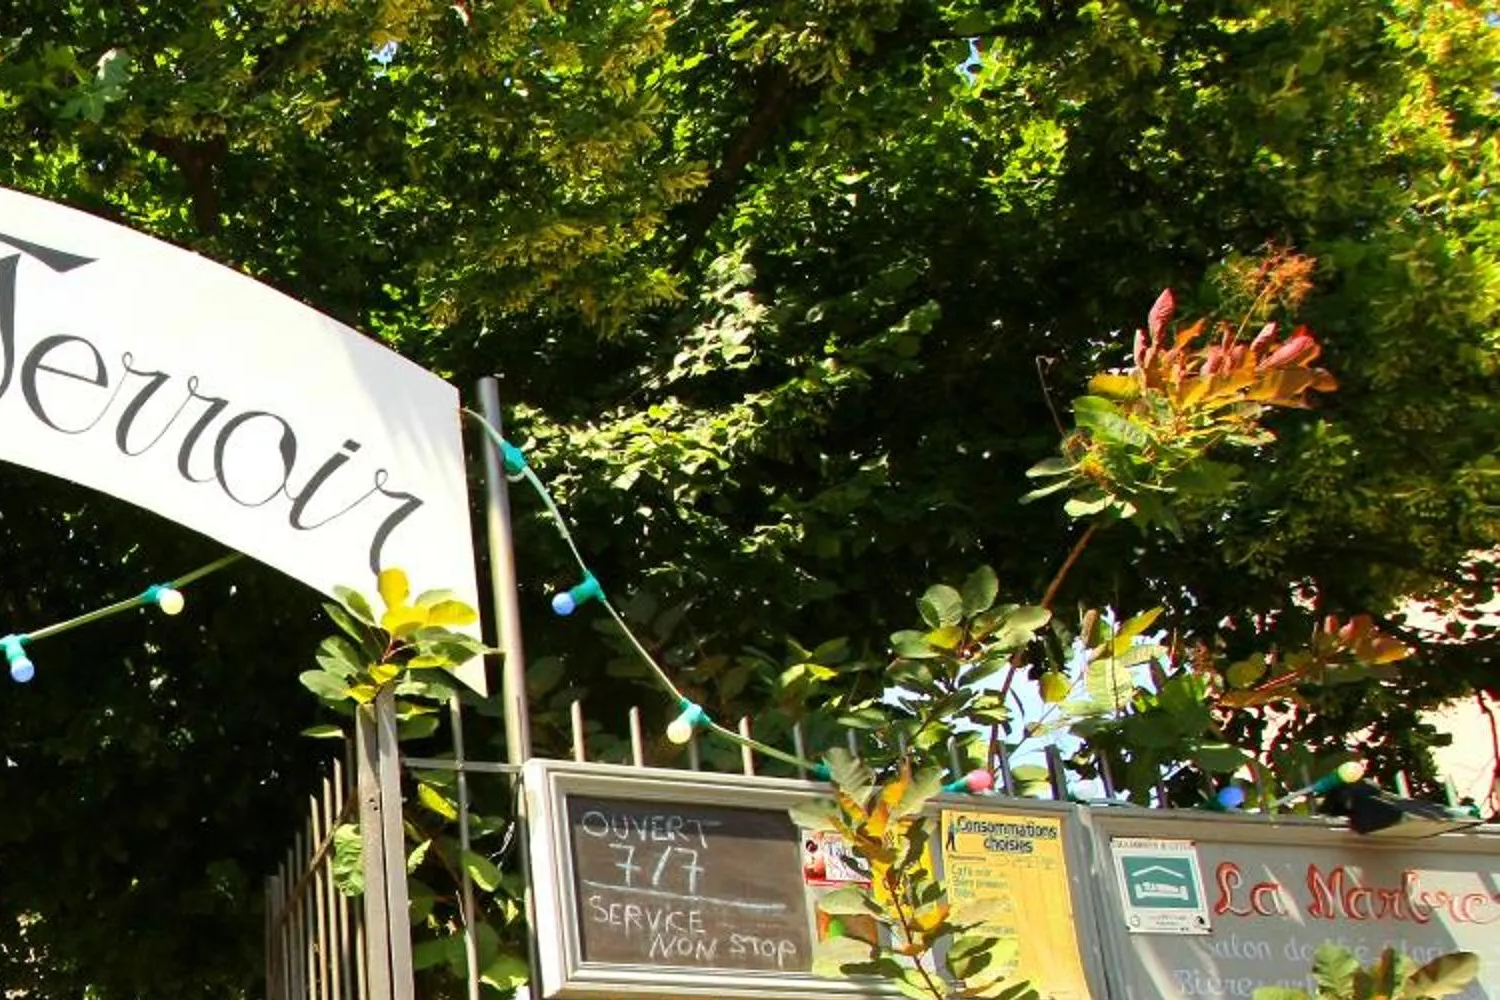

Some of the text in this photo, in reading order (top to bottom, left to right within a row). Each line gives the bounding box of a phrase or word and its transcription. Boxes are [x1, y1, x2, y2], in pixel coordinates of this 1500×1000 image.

[582, 810, 722, 849] OUVERT
[957, 815, 1058, 838] Consommations
[608, 843, 705, 893] 7/7
[1213, 860, 1500, 924] La Marbre
[589, 895, 706, 936] SERVICE
[649, 934, 798, 968] NON STOP
